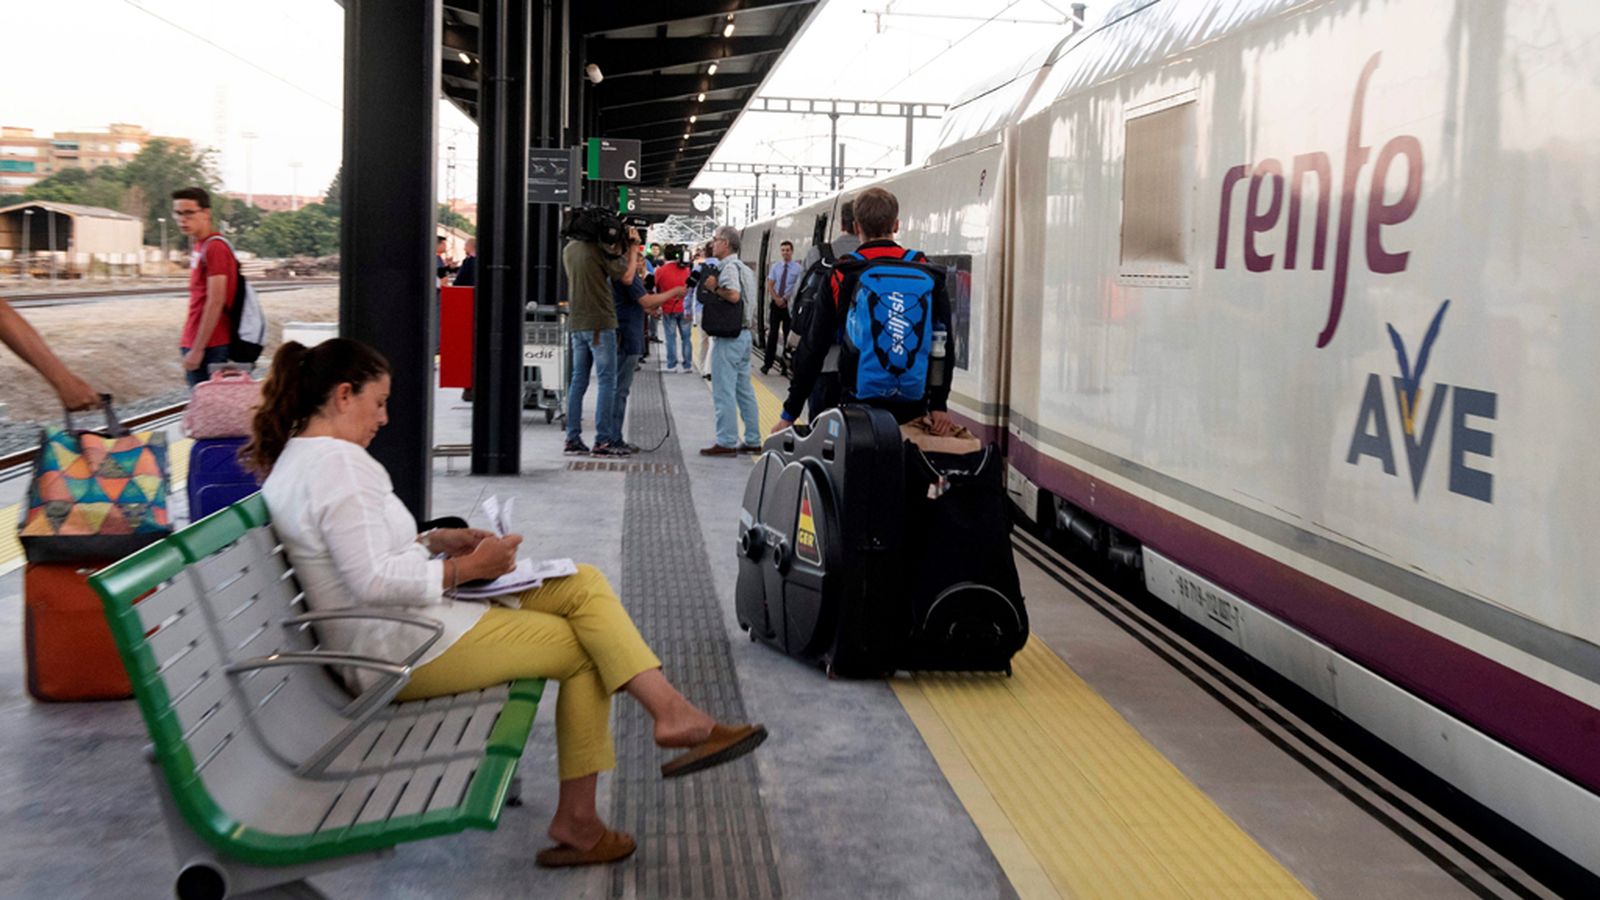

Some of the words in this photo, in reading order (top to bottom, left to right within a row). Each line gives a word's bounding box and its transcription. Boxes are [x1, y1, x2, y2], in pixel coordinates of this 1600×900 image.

[624, 160, 637, 180] 6
[627, 200, 636, 211] 6
[1215, 51, 1424, 348] renfe
[888, 291, 910, 355] sailfish
[525, 351, 555, 359] adif
[1346, 335, 1498, 504] AVE
[799, 530, 815, 547] GER
